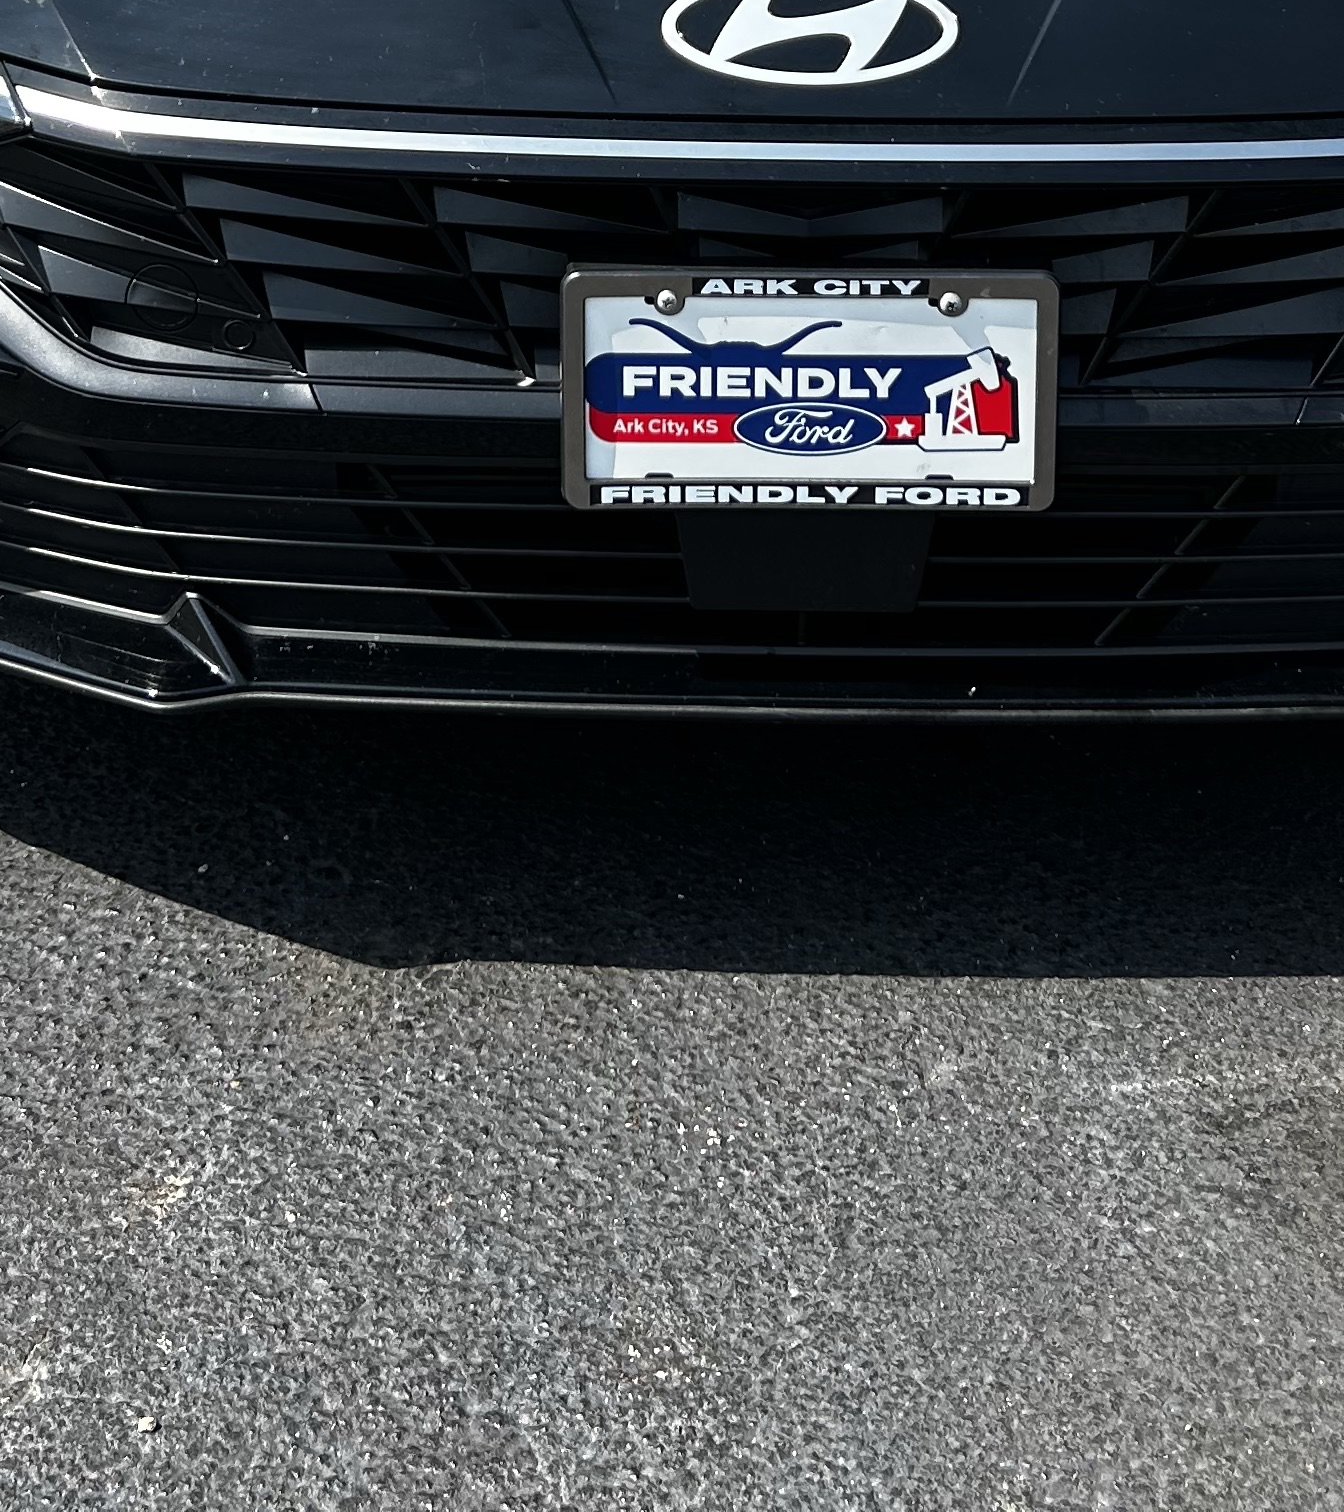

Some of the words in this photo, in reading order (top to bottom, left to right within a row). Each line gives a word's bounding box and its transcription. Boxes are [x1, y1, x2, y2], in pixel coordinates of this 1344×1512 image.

[700, 278, 799, 295] ARK
[813, 279, 922, 296] CITY
[622, 365, 903, 399] FRIENDLY
[613, 418, 645, 433] Ark
[648, 418, 689, 435] City,
[693, 418, 719, 433] KS
[764, 407, 856, 445] Ford
[600, 485, 859, 504] FRIENDLY
[874, 486, 1021, 506] FORD
